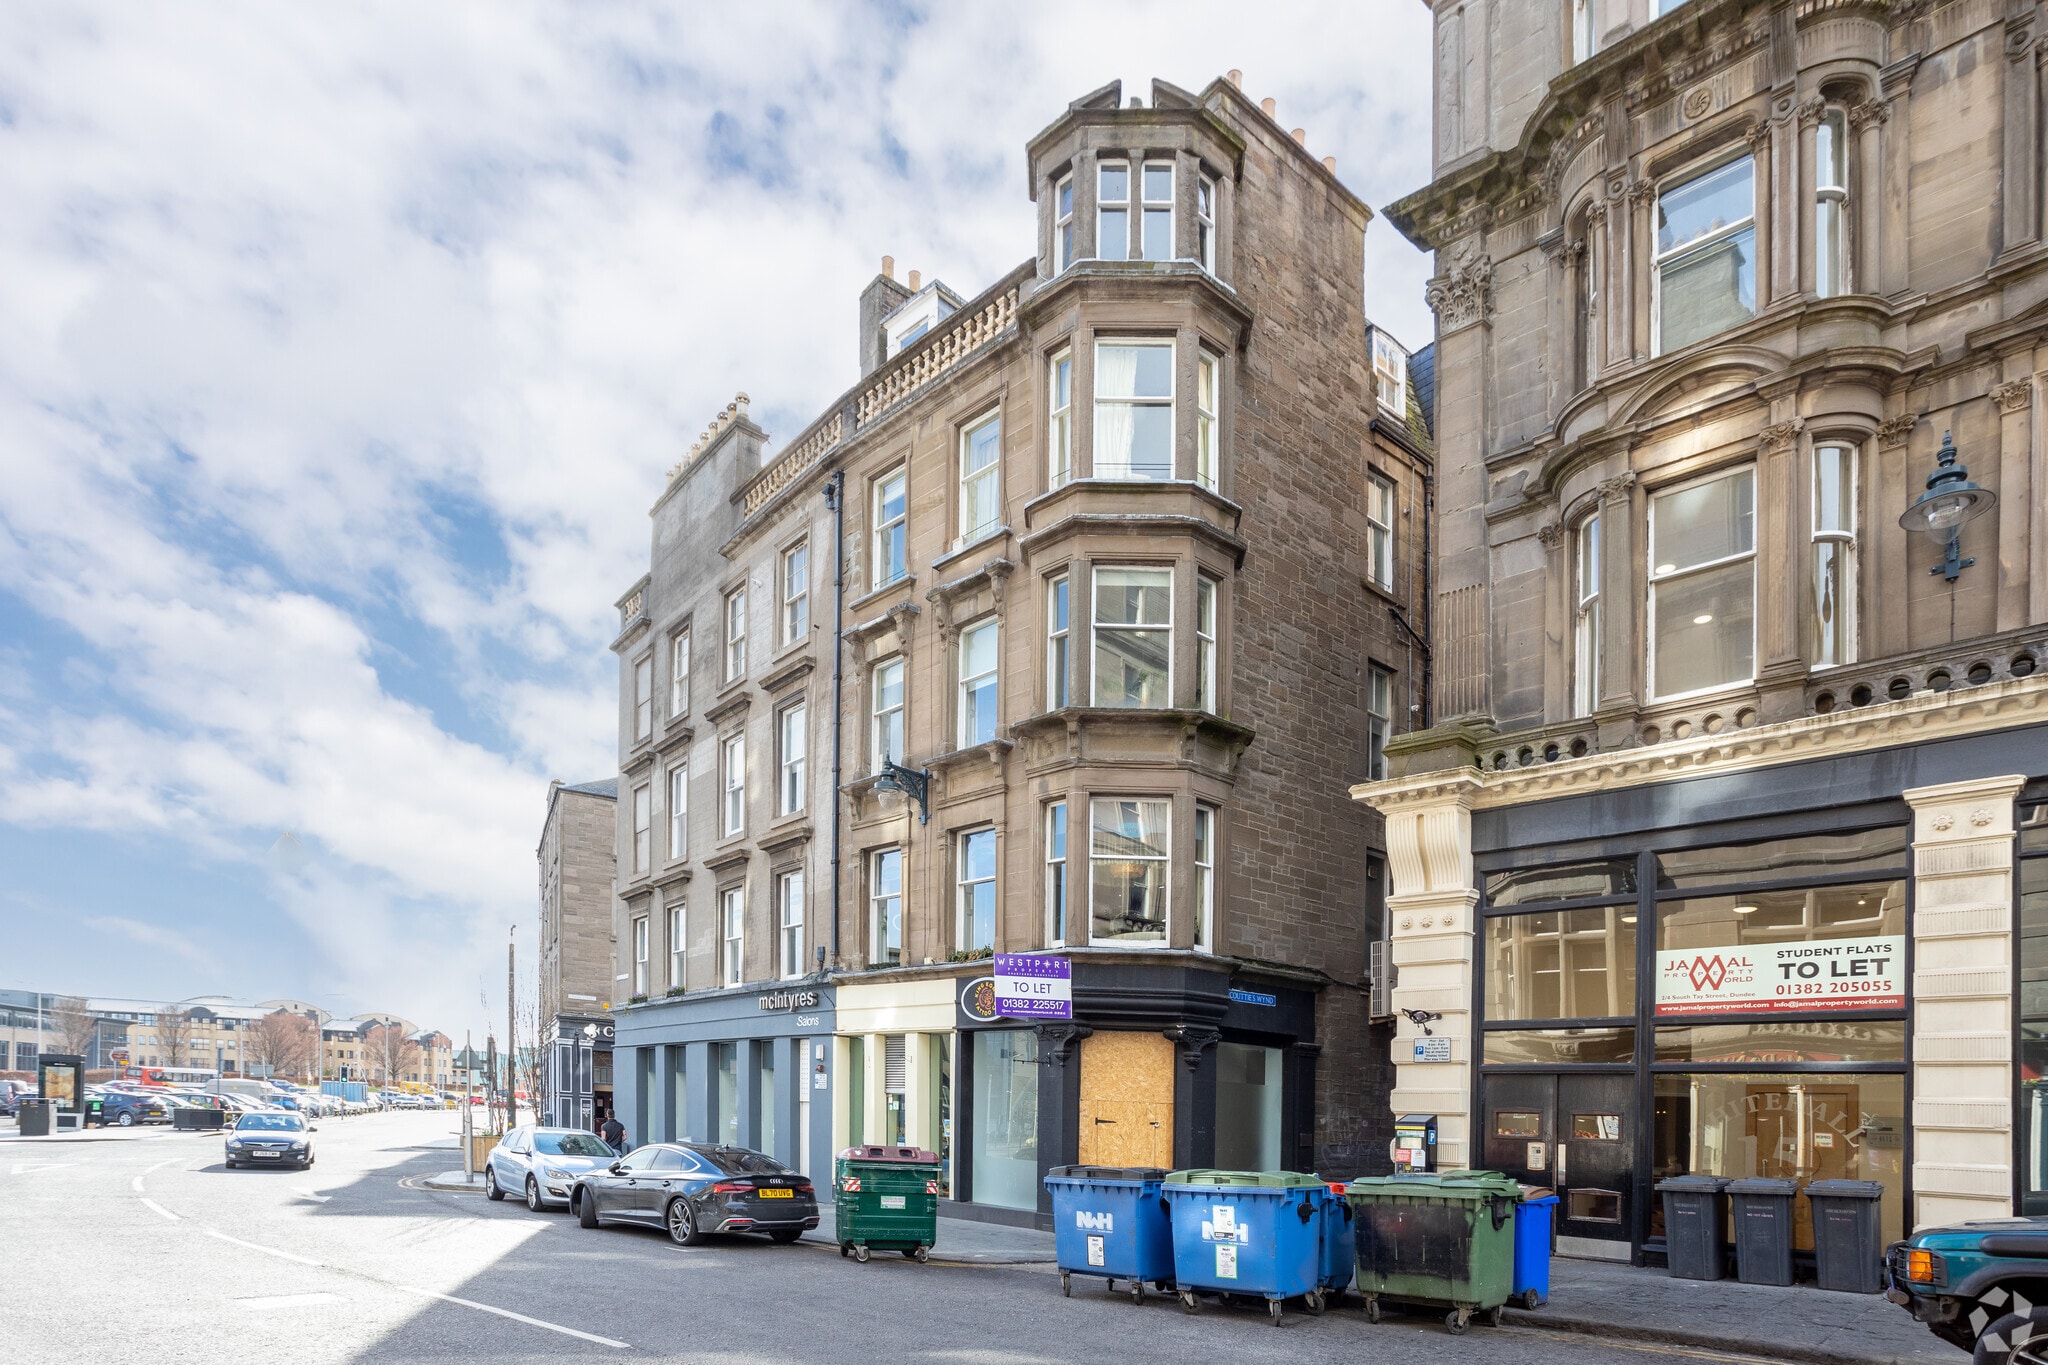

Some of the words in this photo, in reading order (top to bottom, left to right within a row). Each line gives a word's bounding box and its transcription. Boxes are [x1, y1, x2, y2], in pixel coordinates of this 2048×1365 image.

[1777, 947, 1842, 959] STUDENT
[1846, 944, 1892, 955] FLATS
[1664, 955, 1754, 973] JAMAL
[1778, 961, 1820, 980] TO
[1831, 958, 1890, 978] LET
[1664, 969, 1753, 978] PROPERTY
[1013, 982, 1029, 993] TO
[1033, 983, 1052, 994] LET
[1776, 983, 1823, 995] 01382
[1830, 980, 1892, 993] 205055
[1002, 999, 1030, 1009] 01382
[1032, 1000, 1065, 1010] 225517
[1256, 995, 1274, 1005] WYND
[1661, 1002, 1769, 1012] www.jamalpropertyworld.com
[1773, 998, 1898, 1009] info@jamalpropertyworld.com
[796, 1015, 820, 1027] Salons
[1699, 1093, 1867, 1148] HITEHALL
[1076, 1210, 1113, 1230] NWH
[1202, 1220, 1249, 1242] NH
